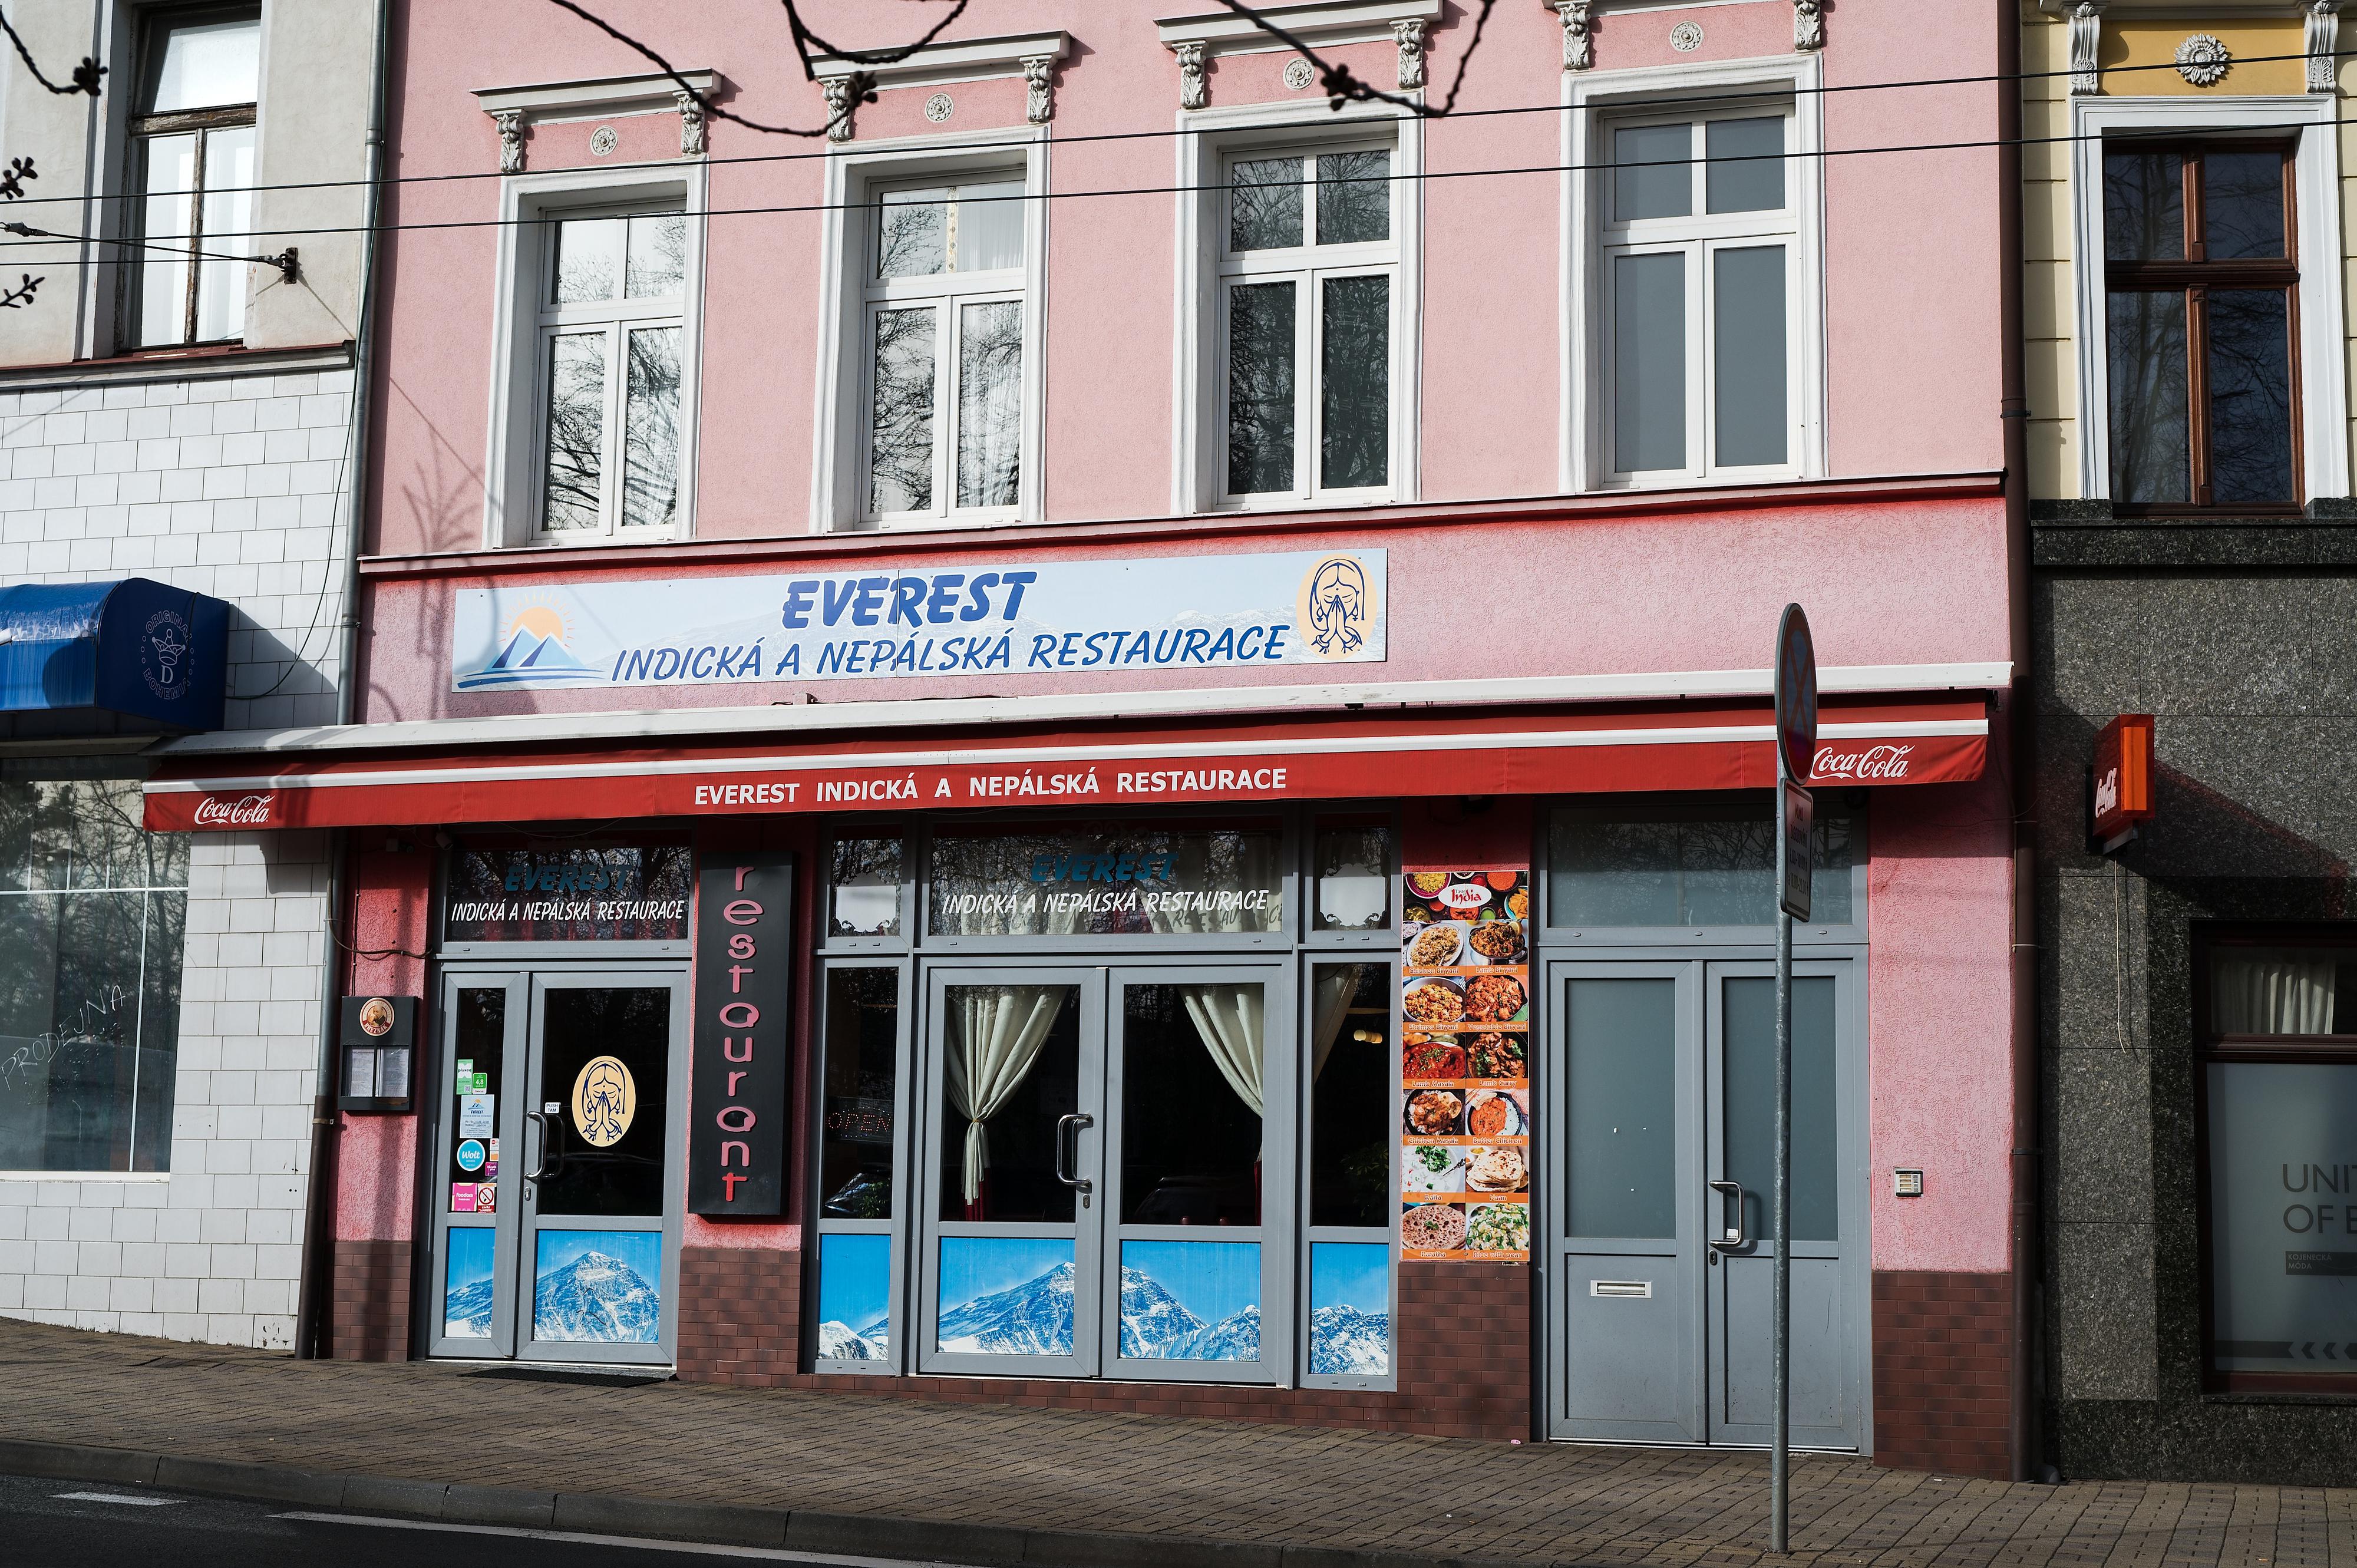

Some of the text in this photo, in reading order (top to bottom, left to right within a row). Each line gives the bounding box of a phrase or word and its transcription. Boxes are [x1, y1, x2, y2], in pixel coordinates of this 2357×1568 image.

[783, 571, 1038, 628] EVEREST
[612, 624, 1290, 682] INDICKÁ A NEPÁLSKÁ RESTAURACE
[160, 665, 173, 684] D
[1809, 744, 1916, 780] Coca-Cola
[695, 767, 1287, 805] EVEREST INDICKÁ A NEPÁLSKÁ RESTAURACE
[193, 794, 276, 825] Coca-Cola
[505, 866, 634, 892] EVEREST
[1031, 854, 1178, 883] EVEREST
[451, 898, 685, 921] INDICKÁ A NEPÁLSKÁ RESTAURACE
[942, 888, 1269, 914] INDICKÁ A NEPÁLSKÁ RESTAURACE
[1451, 889, 1481, 906] India
[1437, 967, 1459, 975] Biryani
[1495, 966, 1518, 974] Biryani
[1, 985, 126, 1091] PRODEJNA
[715, 865, 765, 1202] restaurant
[1499, 1080, 1517, 1088] Curry
[828, 1112, 891, 1134] OPEN
[462, 1151, 480, 1159] Wolt
[2283, 1204, 2333, 1233] OF
[2288, 1261, 2312, 1269] MÓDA
